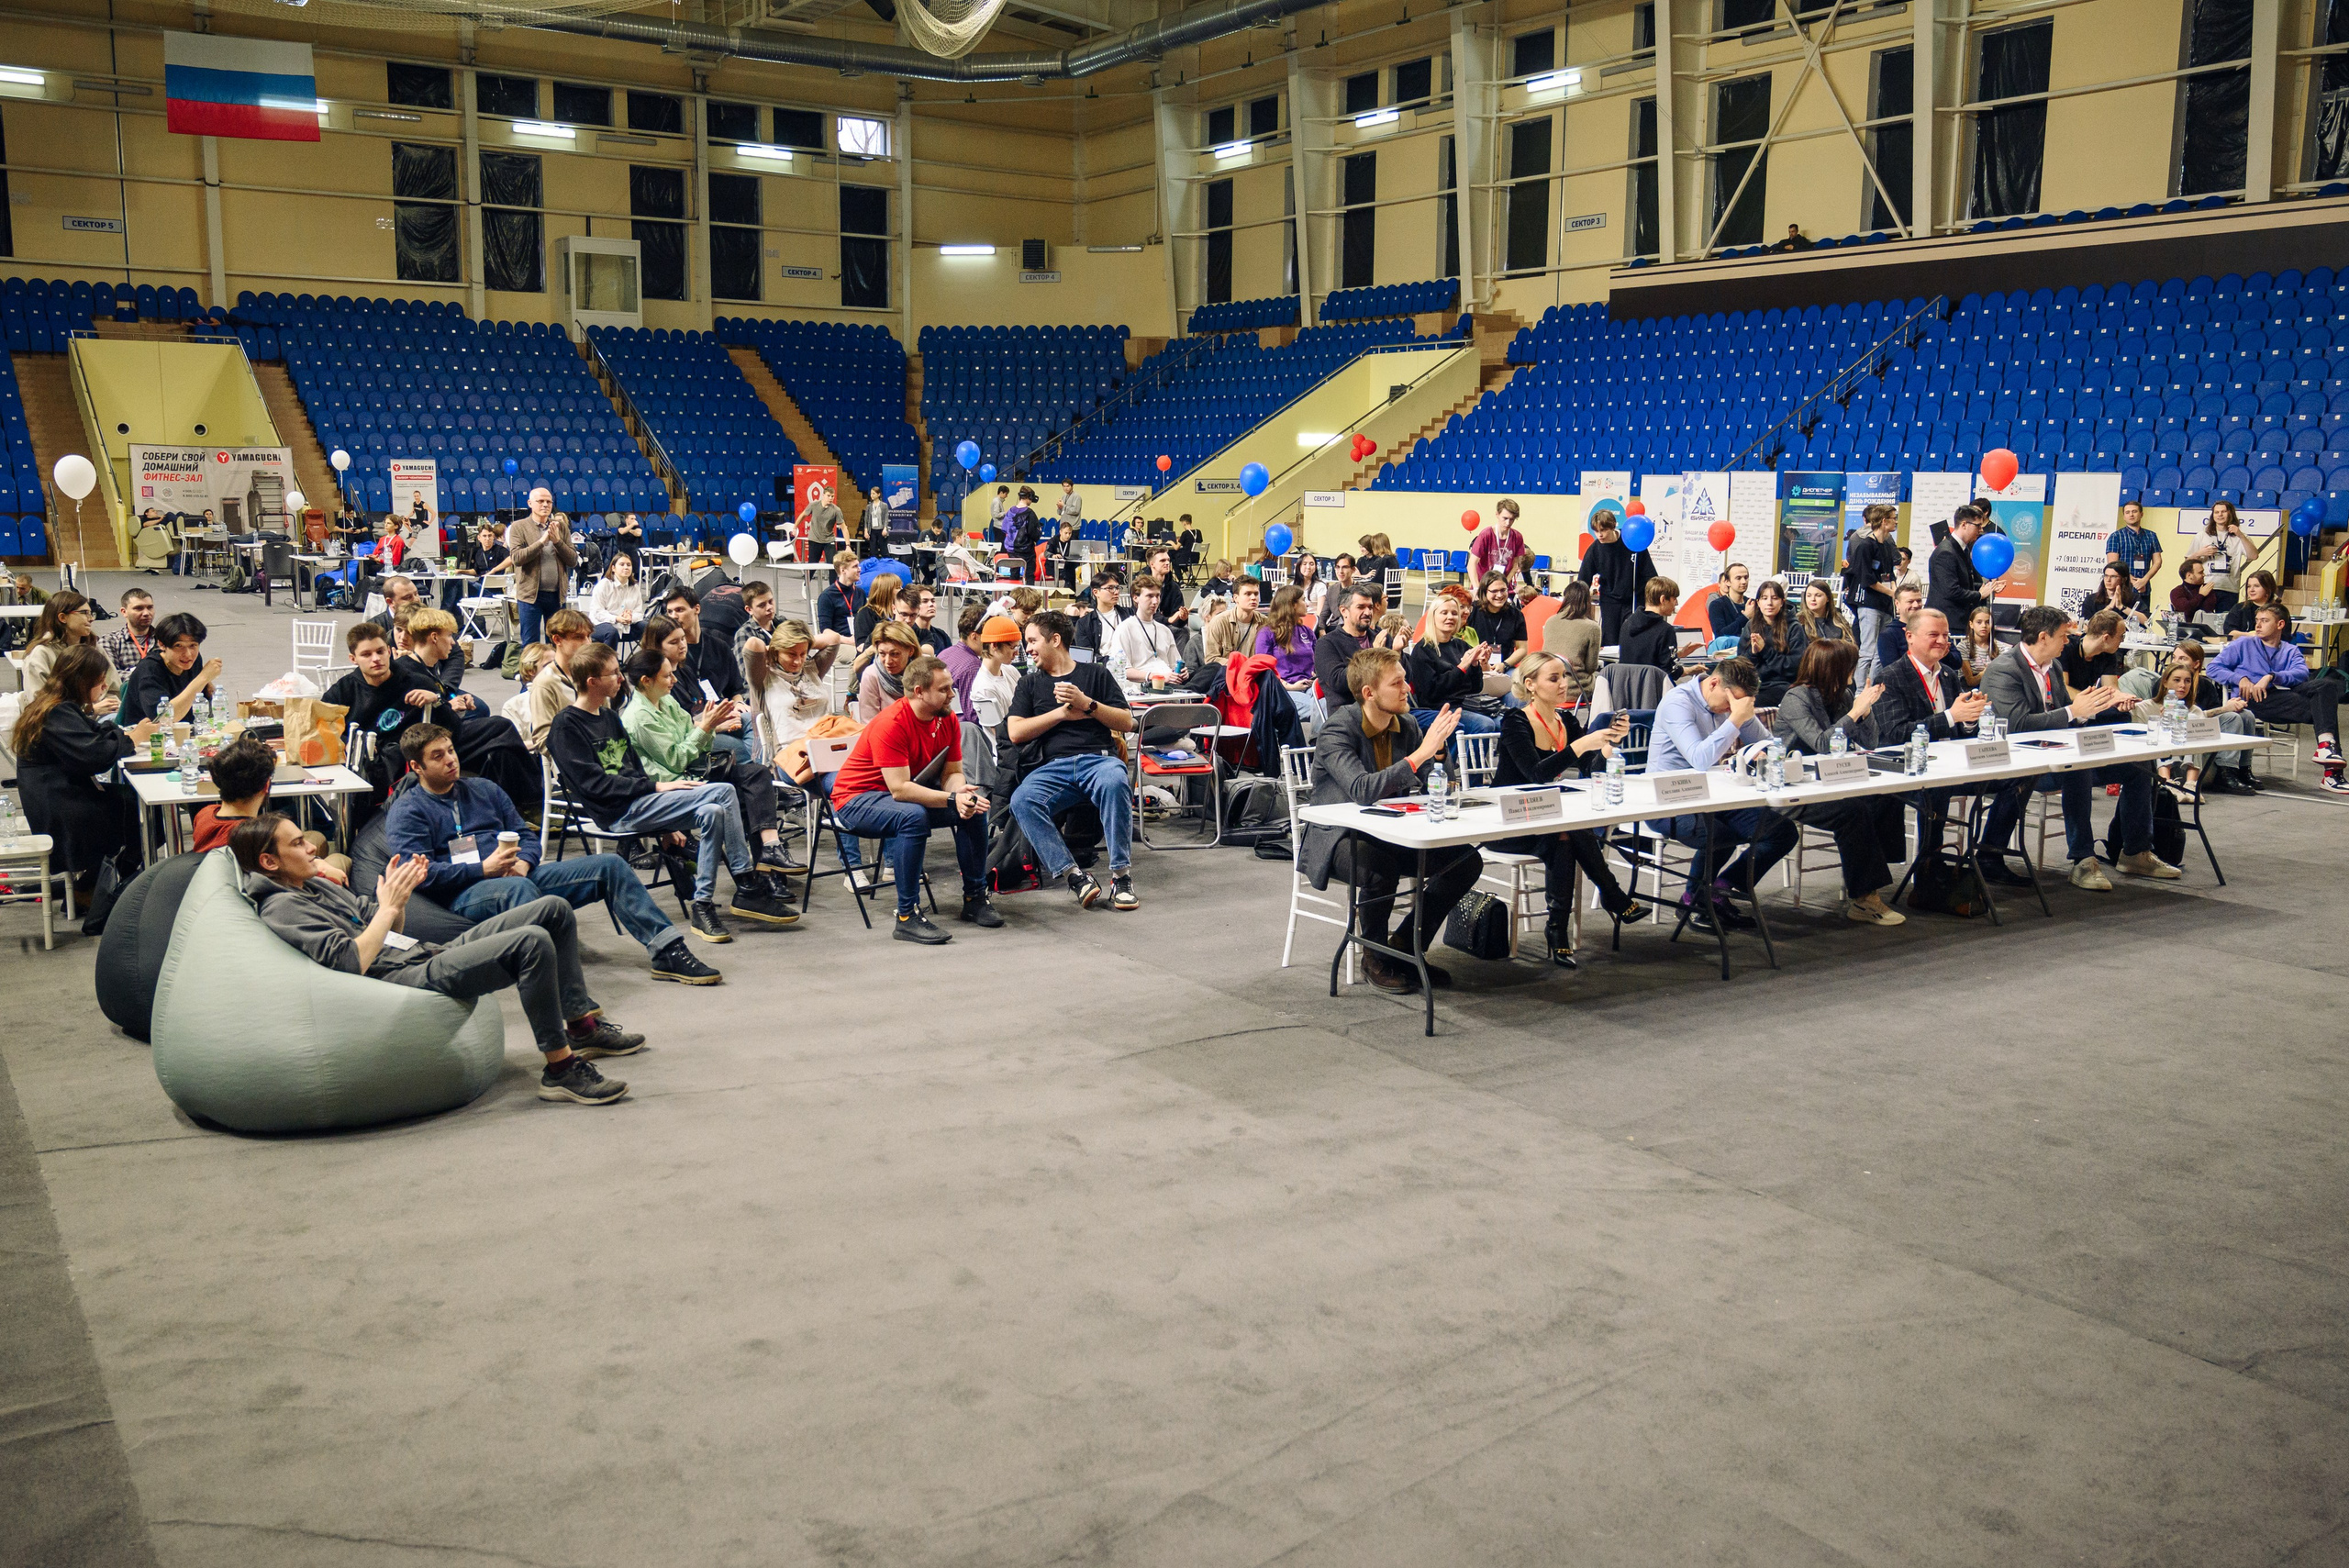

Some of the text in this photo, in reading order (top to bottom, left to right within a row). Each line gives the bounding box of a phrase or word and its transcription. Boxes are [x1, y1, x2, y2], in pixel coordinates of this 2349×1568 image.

[72, 220, 106, 228] СЕКТОР
[1571, 217, 1595, 228] СЕКТОР
[142, 451, 206, 462] СОБЕРИ СВОЙ
[231, 453, 282, 462] YAMAGUCHI
[142, 462, 199, 473] ДОМАШНИЙ
[143, 473, 203, 483] ФИТНЕС-ЗАЛ
[2247, 518, 2254, 528] 2
[2057, 530, 2109, 540] АРСЕНАЛ 67
[2063, 555, 2079, 563] (910)
[2054, 565, 2104, 574] WWW.ARSENAL67.RU
